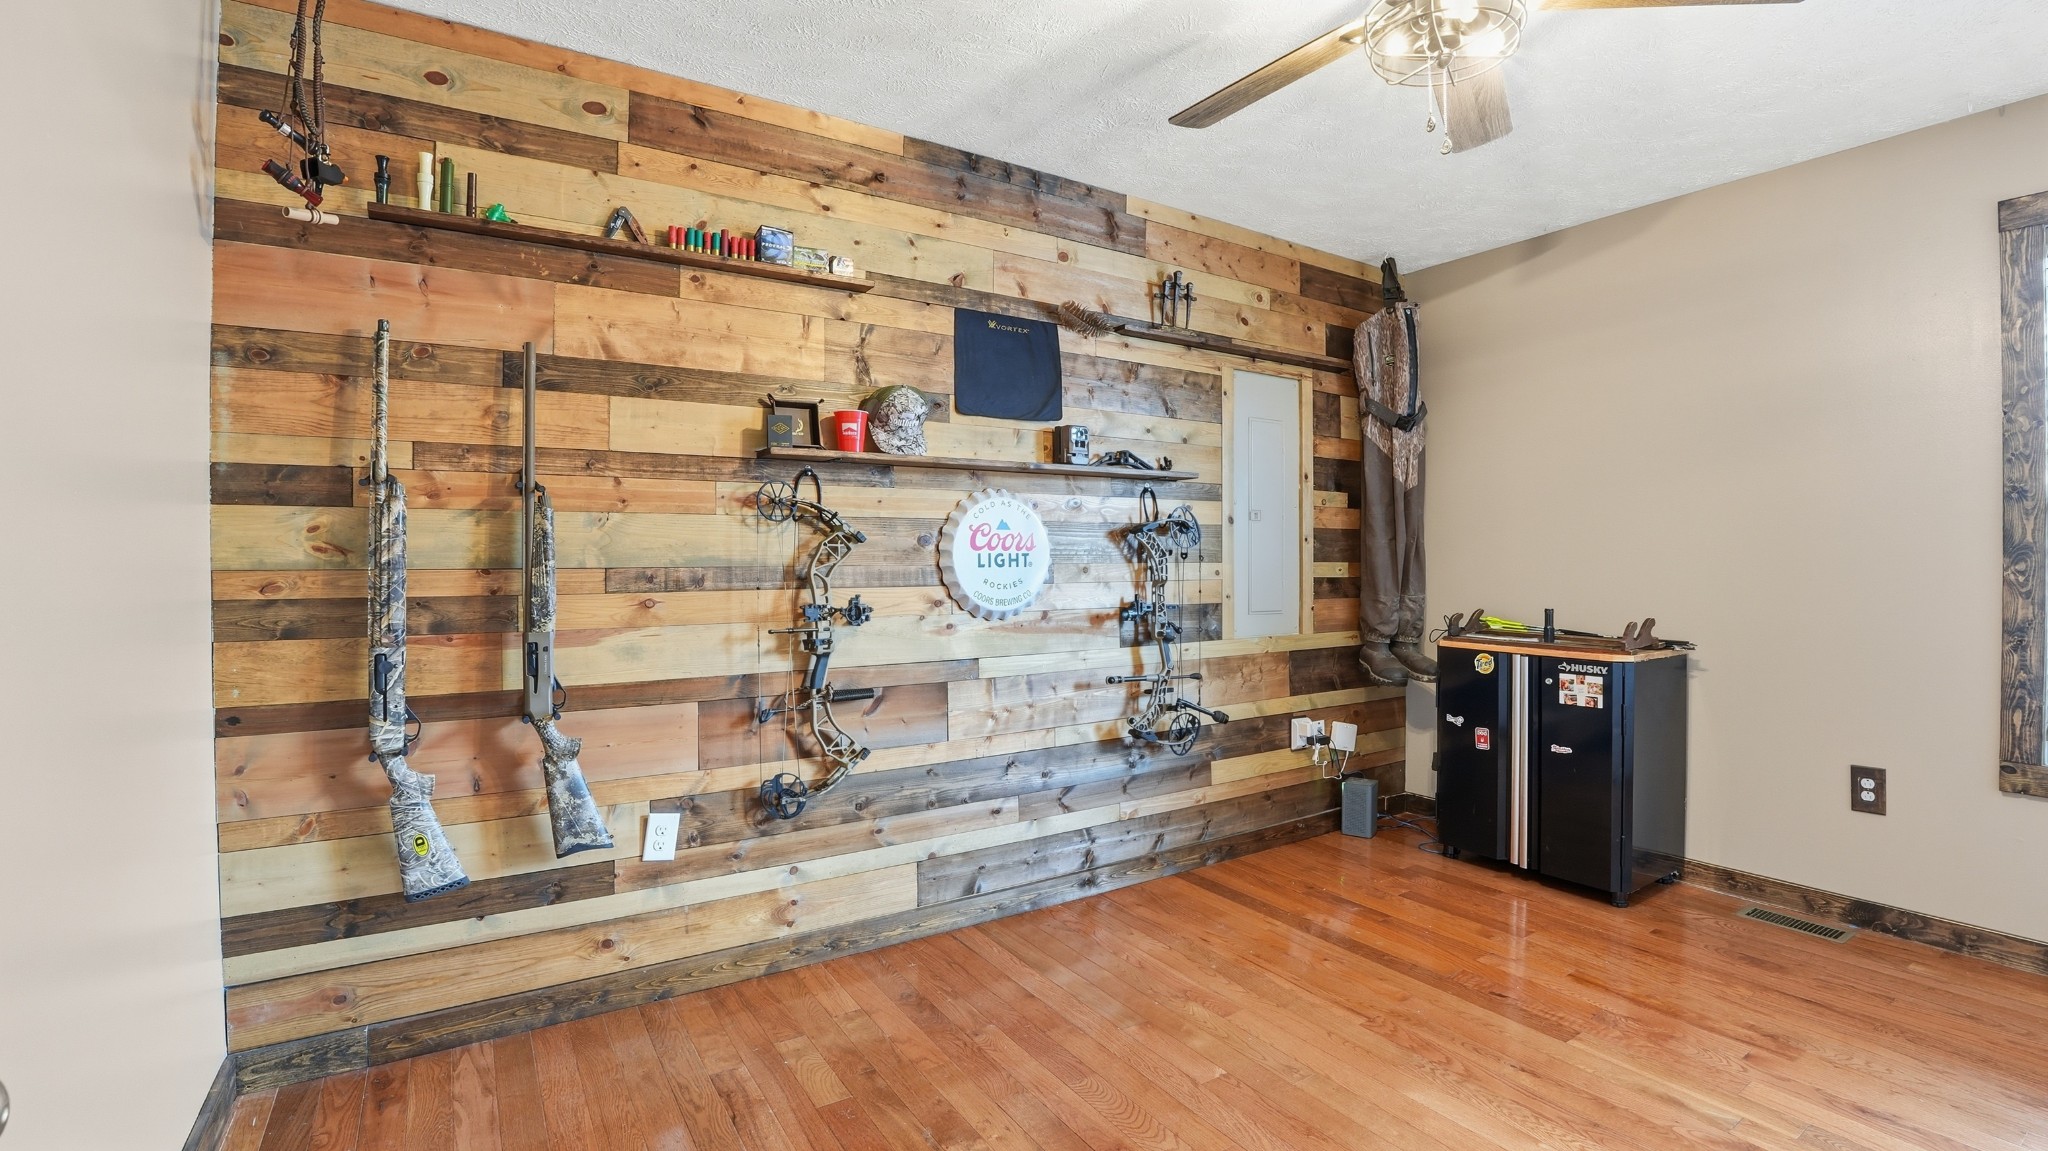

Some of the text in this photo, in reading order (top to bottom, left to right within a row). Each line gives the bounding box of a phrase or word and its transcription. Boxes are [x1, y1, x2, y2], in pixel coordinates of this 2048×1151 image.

[995, 324, 1028, 334] VORTEX
[973, 500, 1031, 520] COLD AS THE
[969, 523, 1036, 551] Coors
[977, 553, 1029, 568] LIGHT
[983, 578, 1023, 590] ROCKIES
[973, 590, 994, 606] COORS
[995, 594, 1023, 607] BREWING
[1570, 663, 1609, 675] HUSKY
